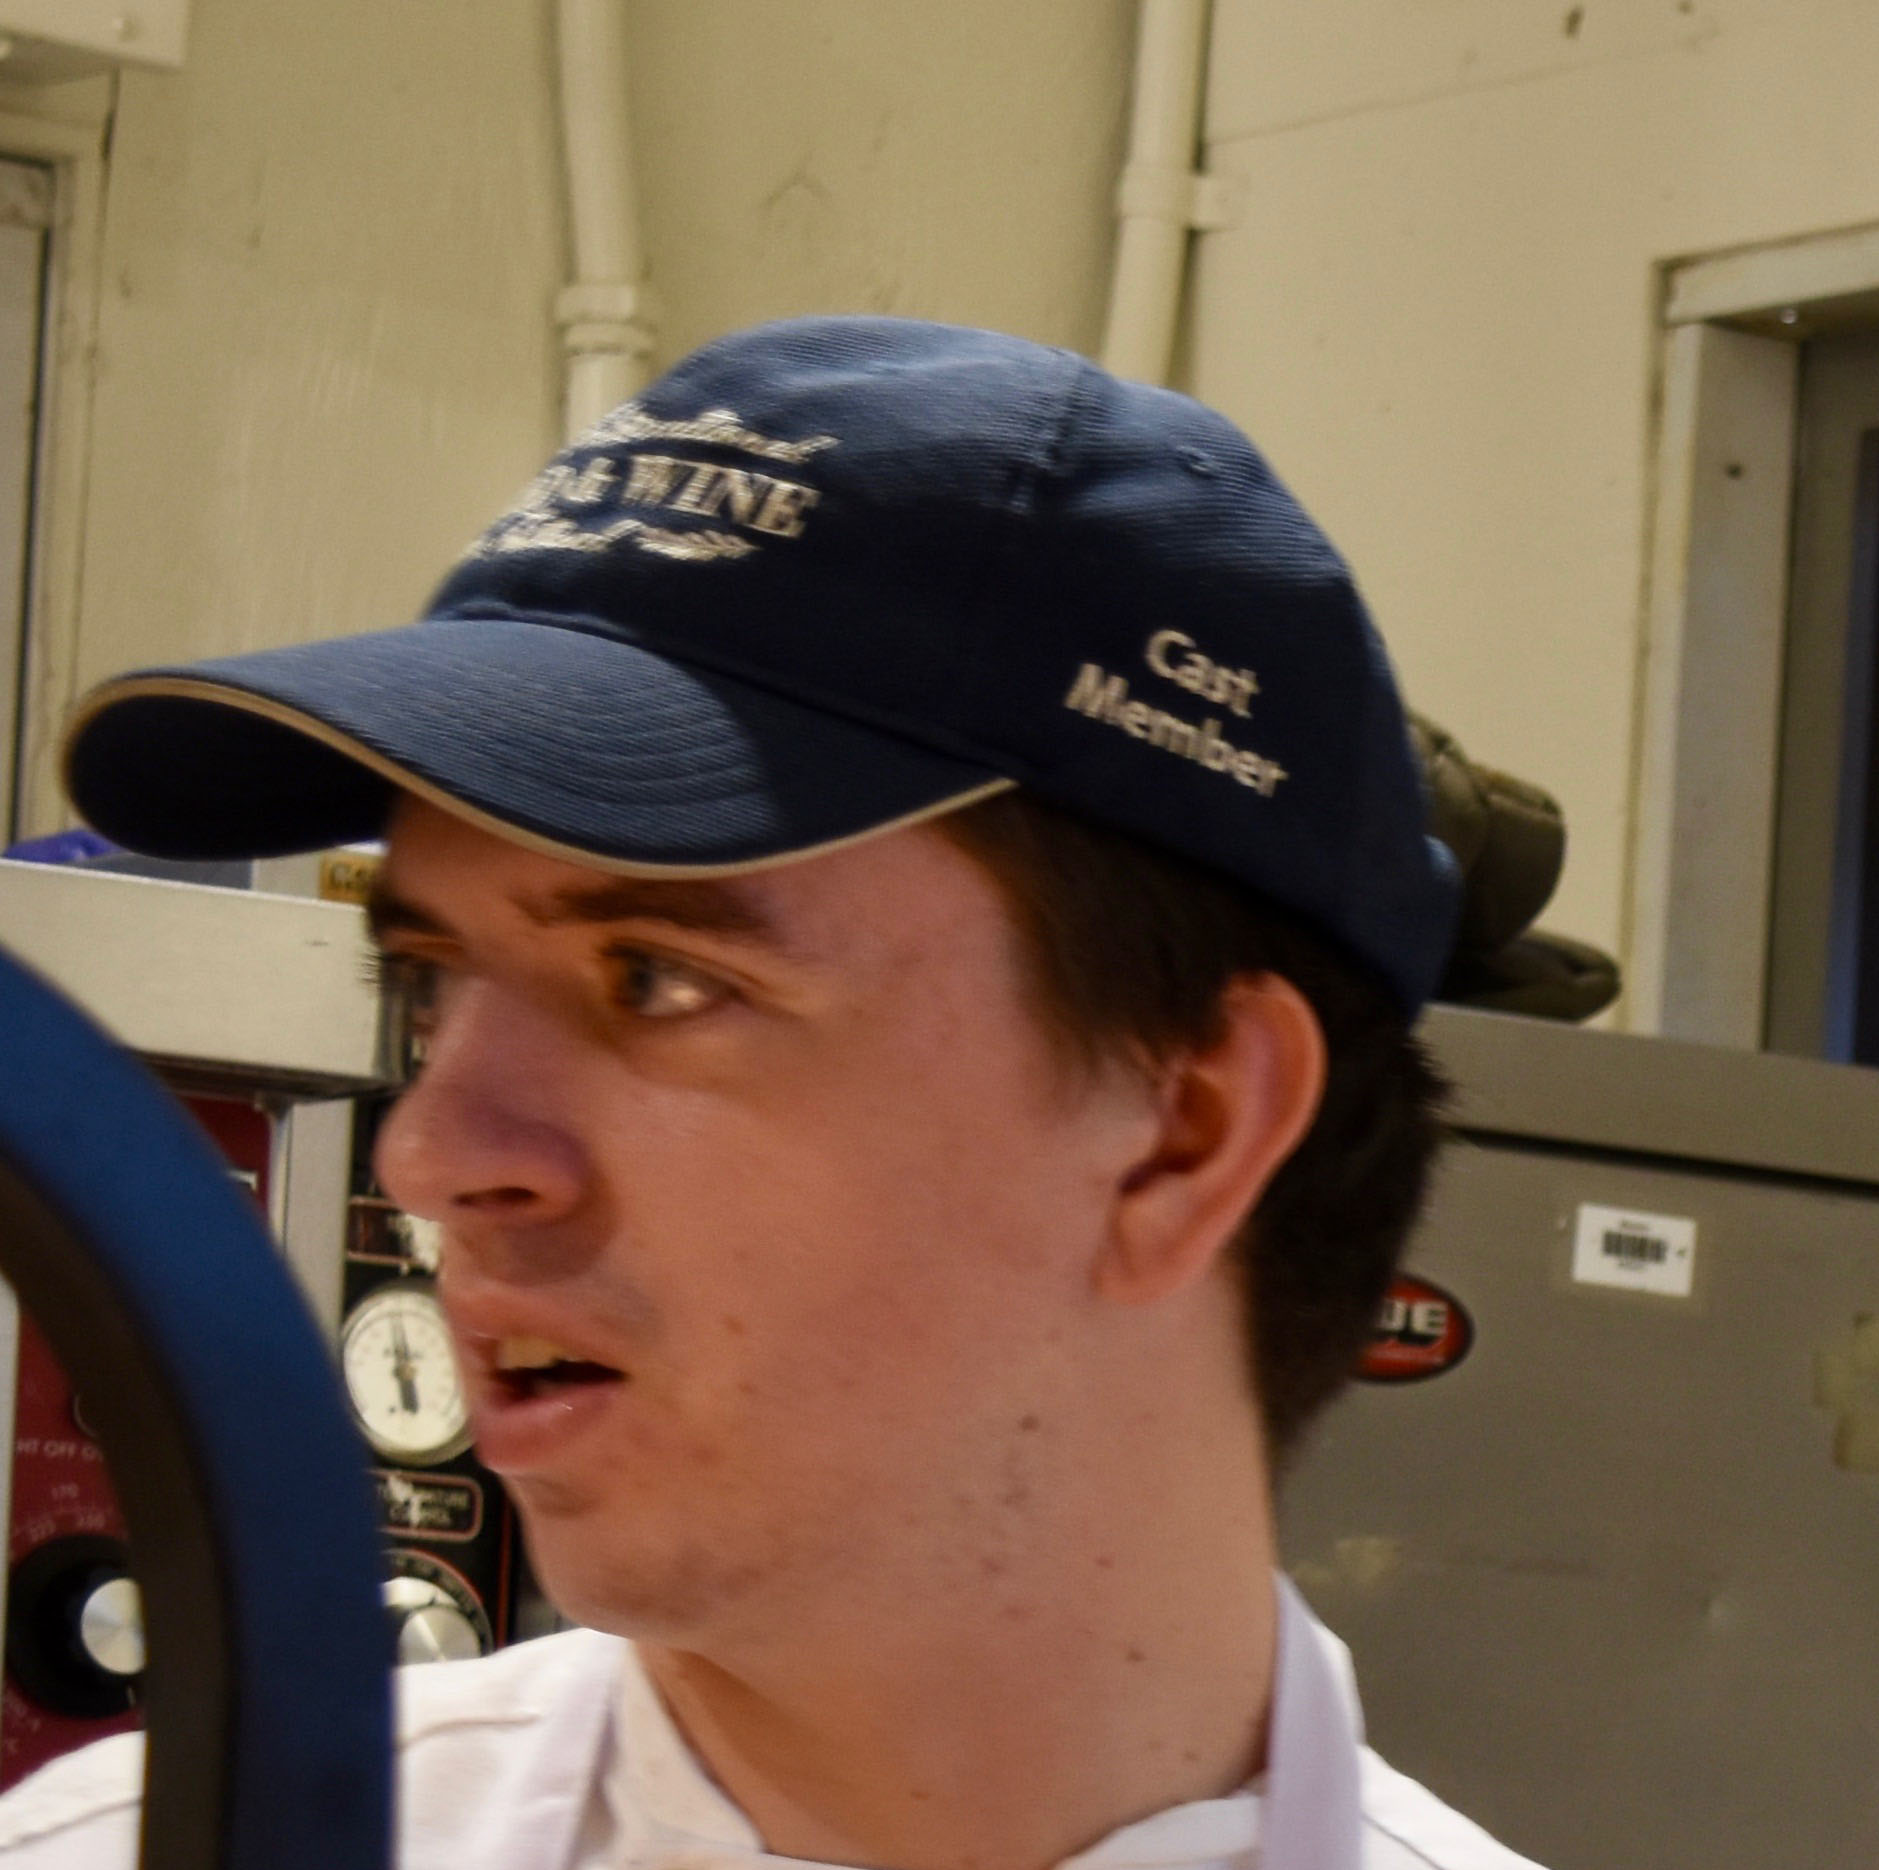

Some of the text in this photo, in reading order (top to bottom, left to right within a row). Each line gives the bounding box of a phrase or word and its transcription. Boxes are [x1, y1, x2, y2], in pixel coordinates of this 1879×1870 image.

[622, 454, 823, 538] WINE
[1145, 629, 1261, 718] Cast
[1064, 662, 1289, 798] Member
